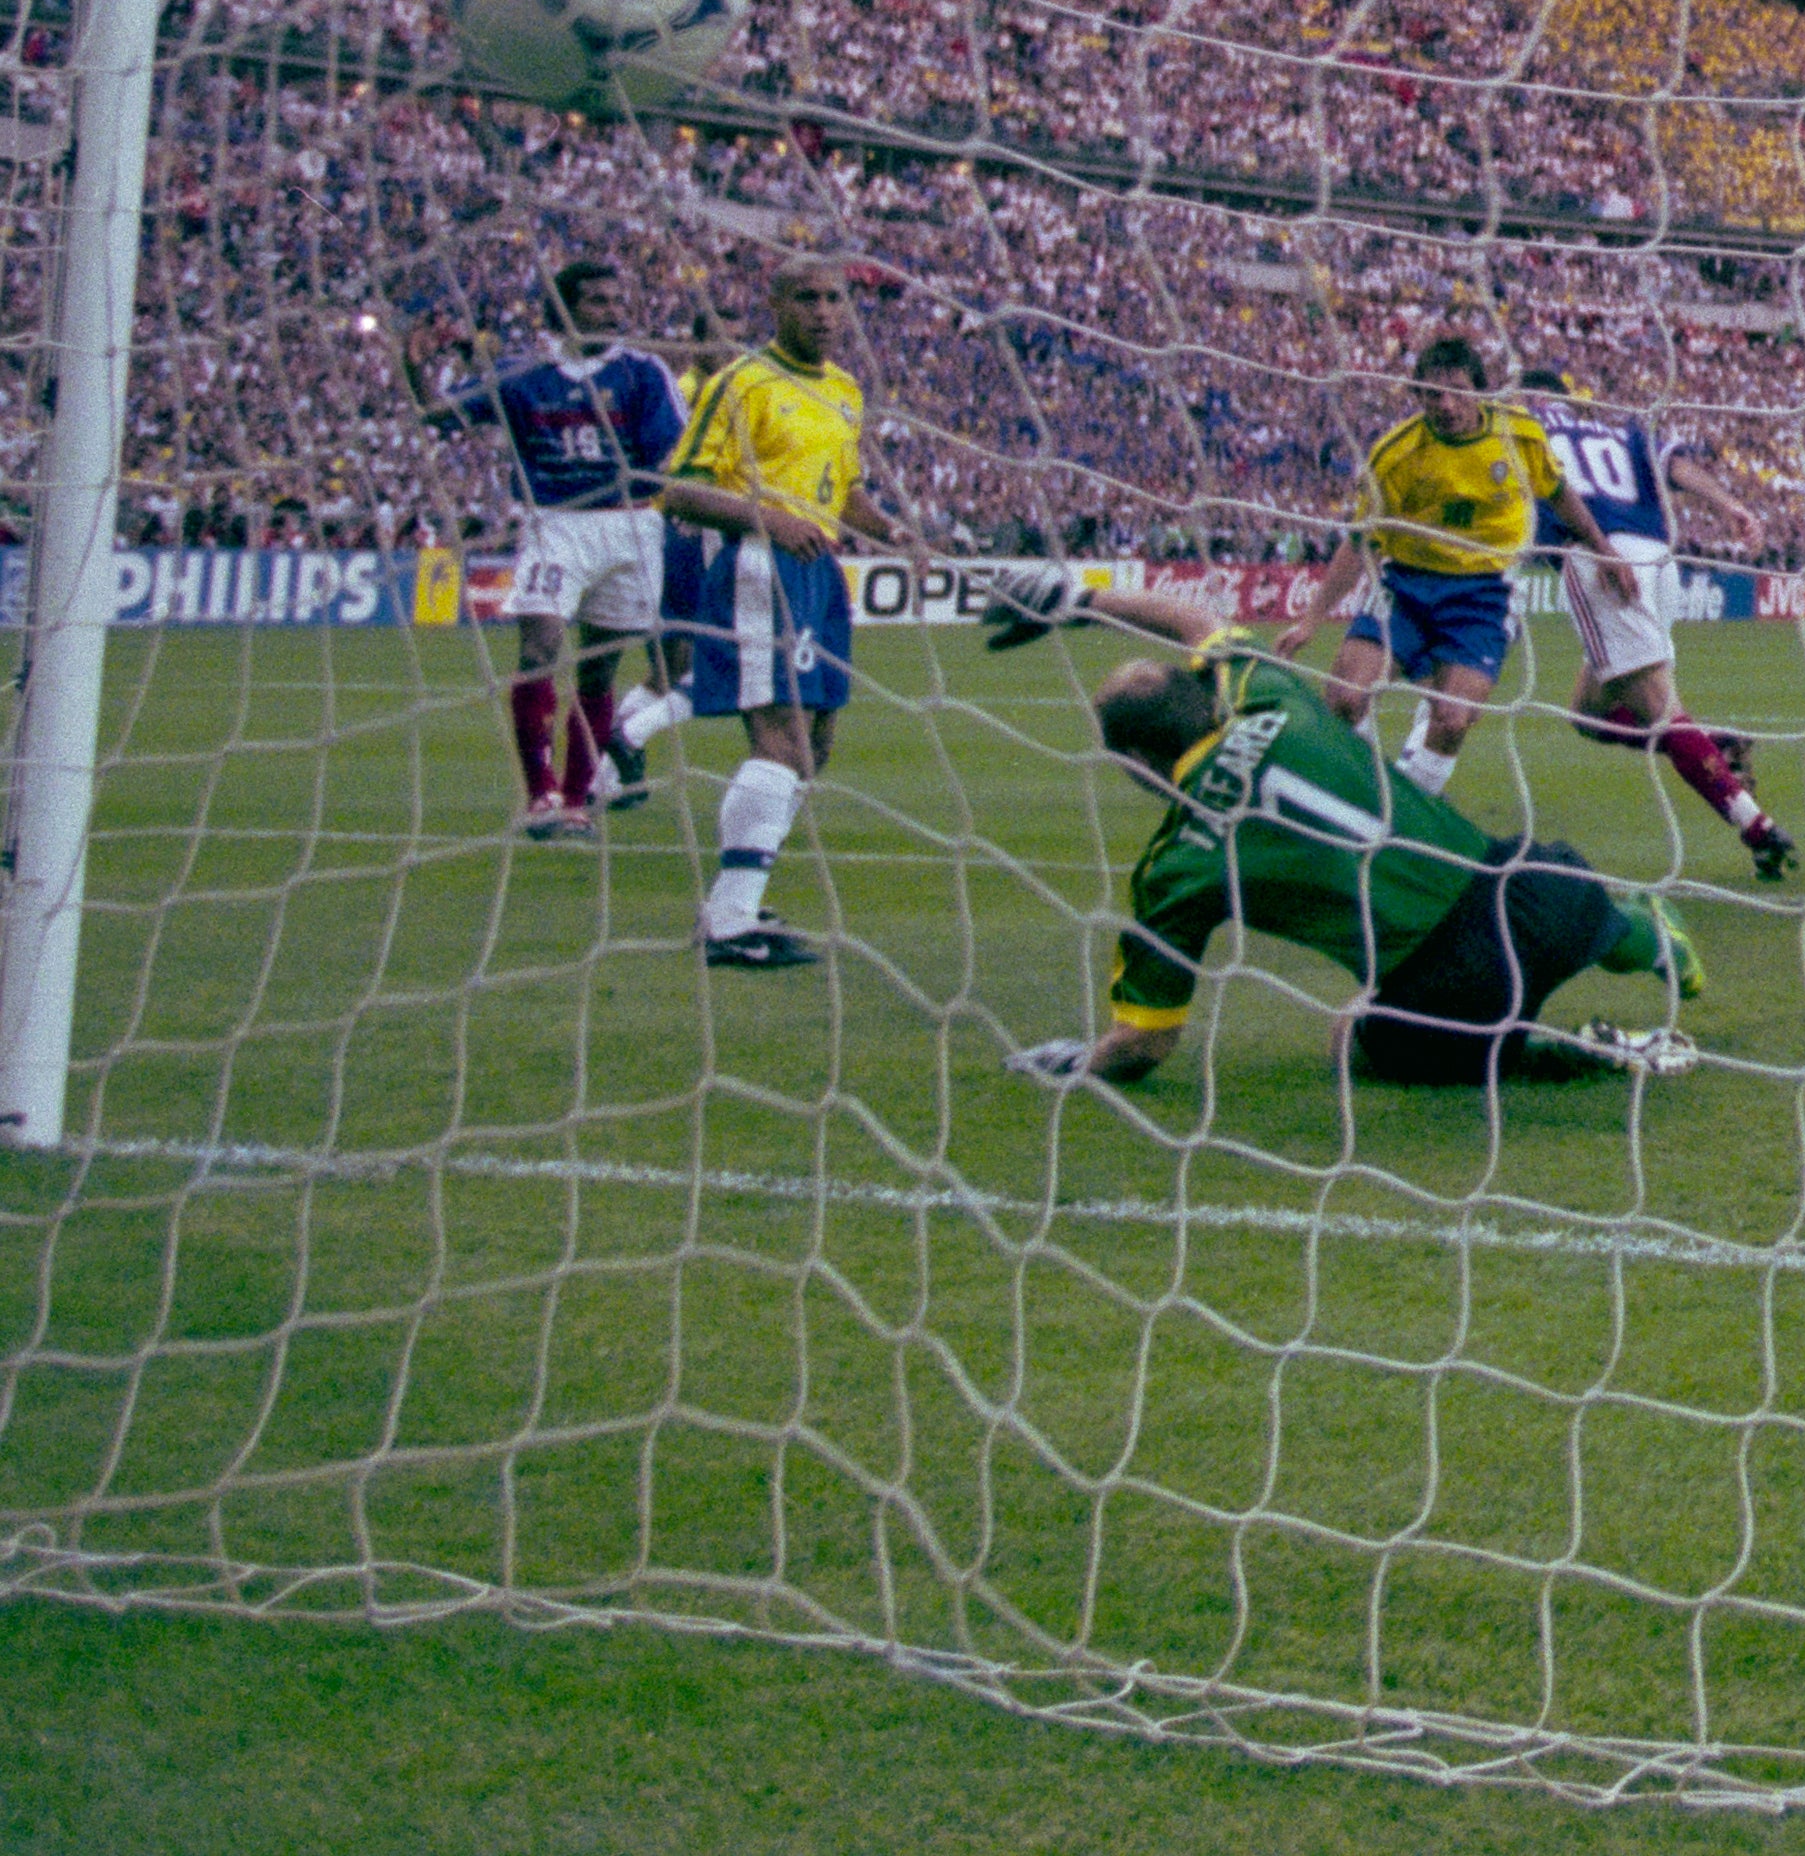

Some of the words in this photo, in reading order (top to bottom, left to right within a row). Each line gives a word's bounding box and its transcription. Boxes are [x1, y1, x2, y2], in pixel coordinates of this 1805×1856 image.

[814, 462, 835, 506] 6
[1551, 433, 1639, 503] 10
[106, 550, 381, 621] PHILIPS
[863, 563, 994, 617] OPE
[792, 626, 817, 672] 6
[1260, 763, 1390, 849] 1
